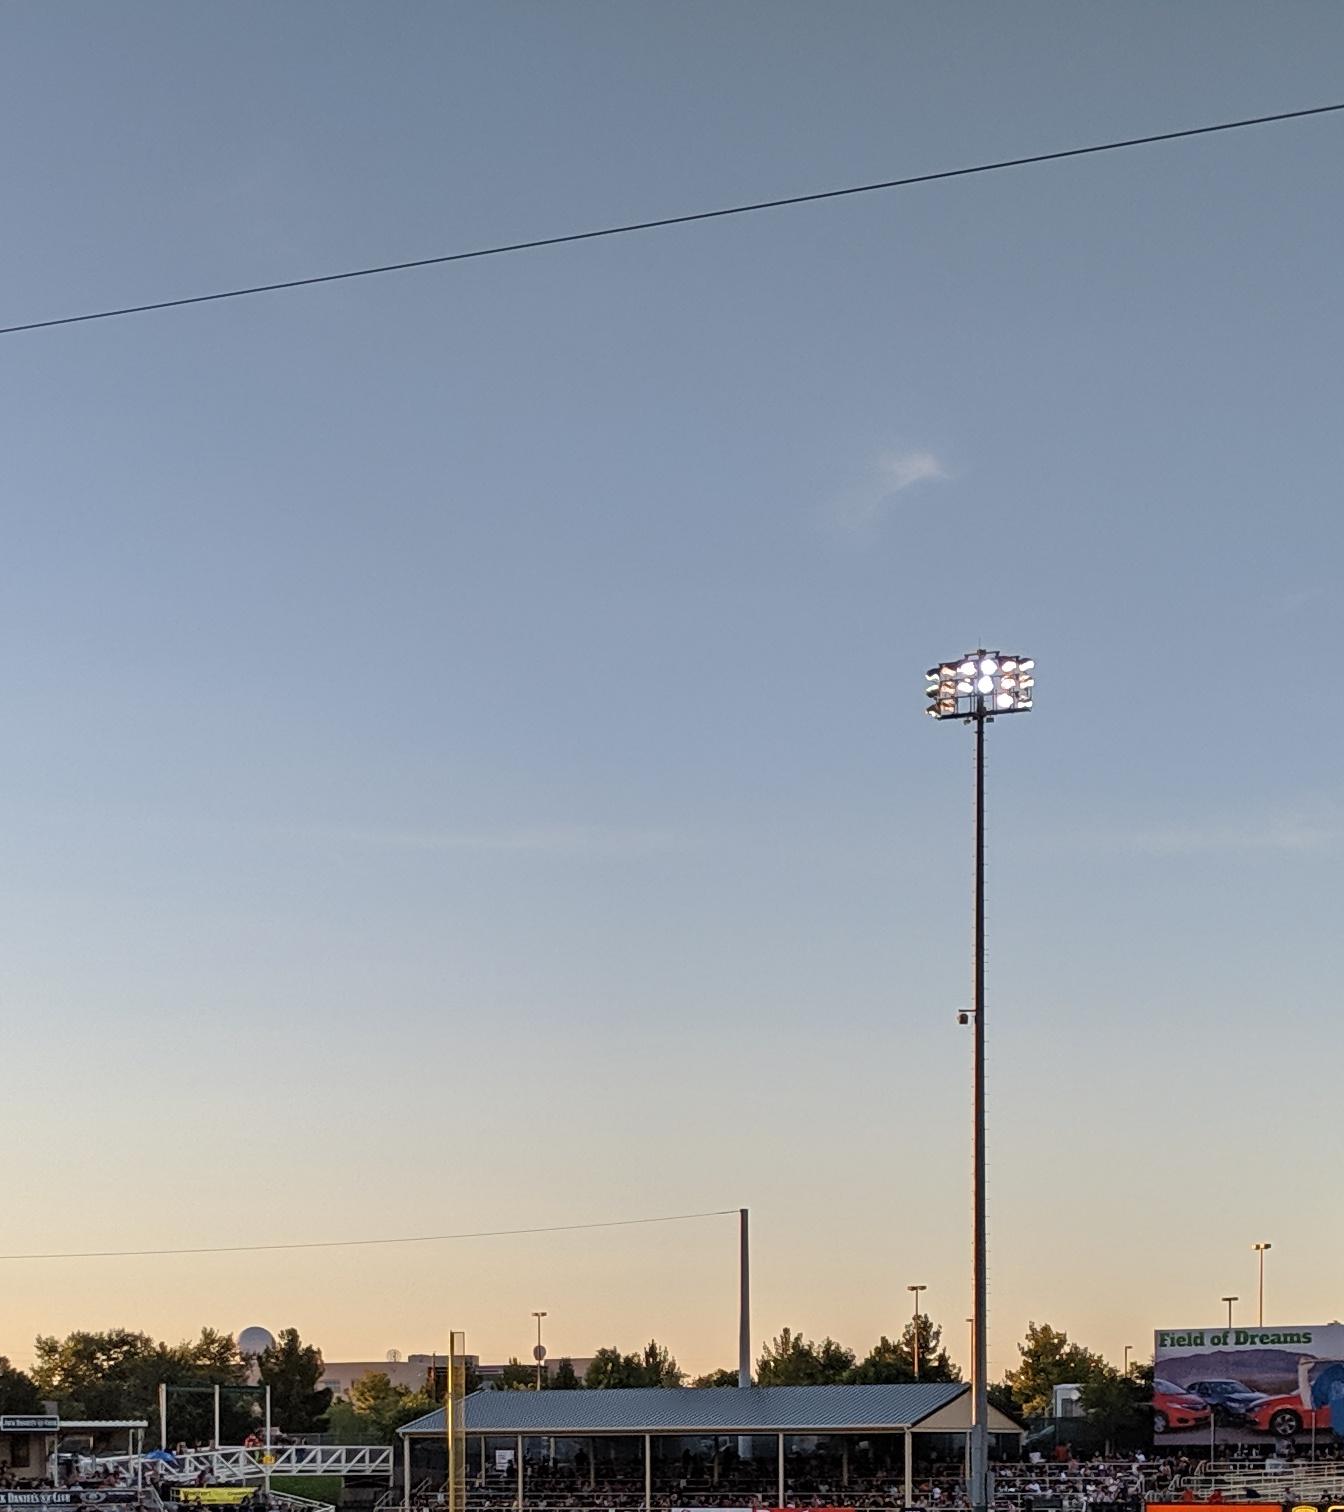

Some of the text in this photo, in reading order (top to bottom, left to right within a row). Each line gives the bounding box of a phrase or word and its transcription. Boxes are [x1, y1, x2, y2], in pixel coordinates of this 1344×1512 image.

[1159, 1330, 1312, 1348] Field of Dreams
